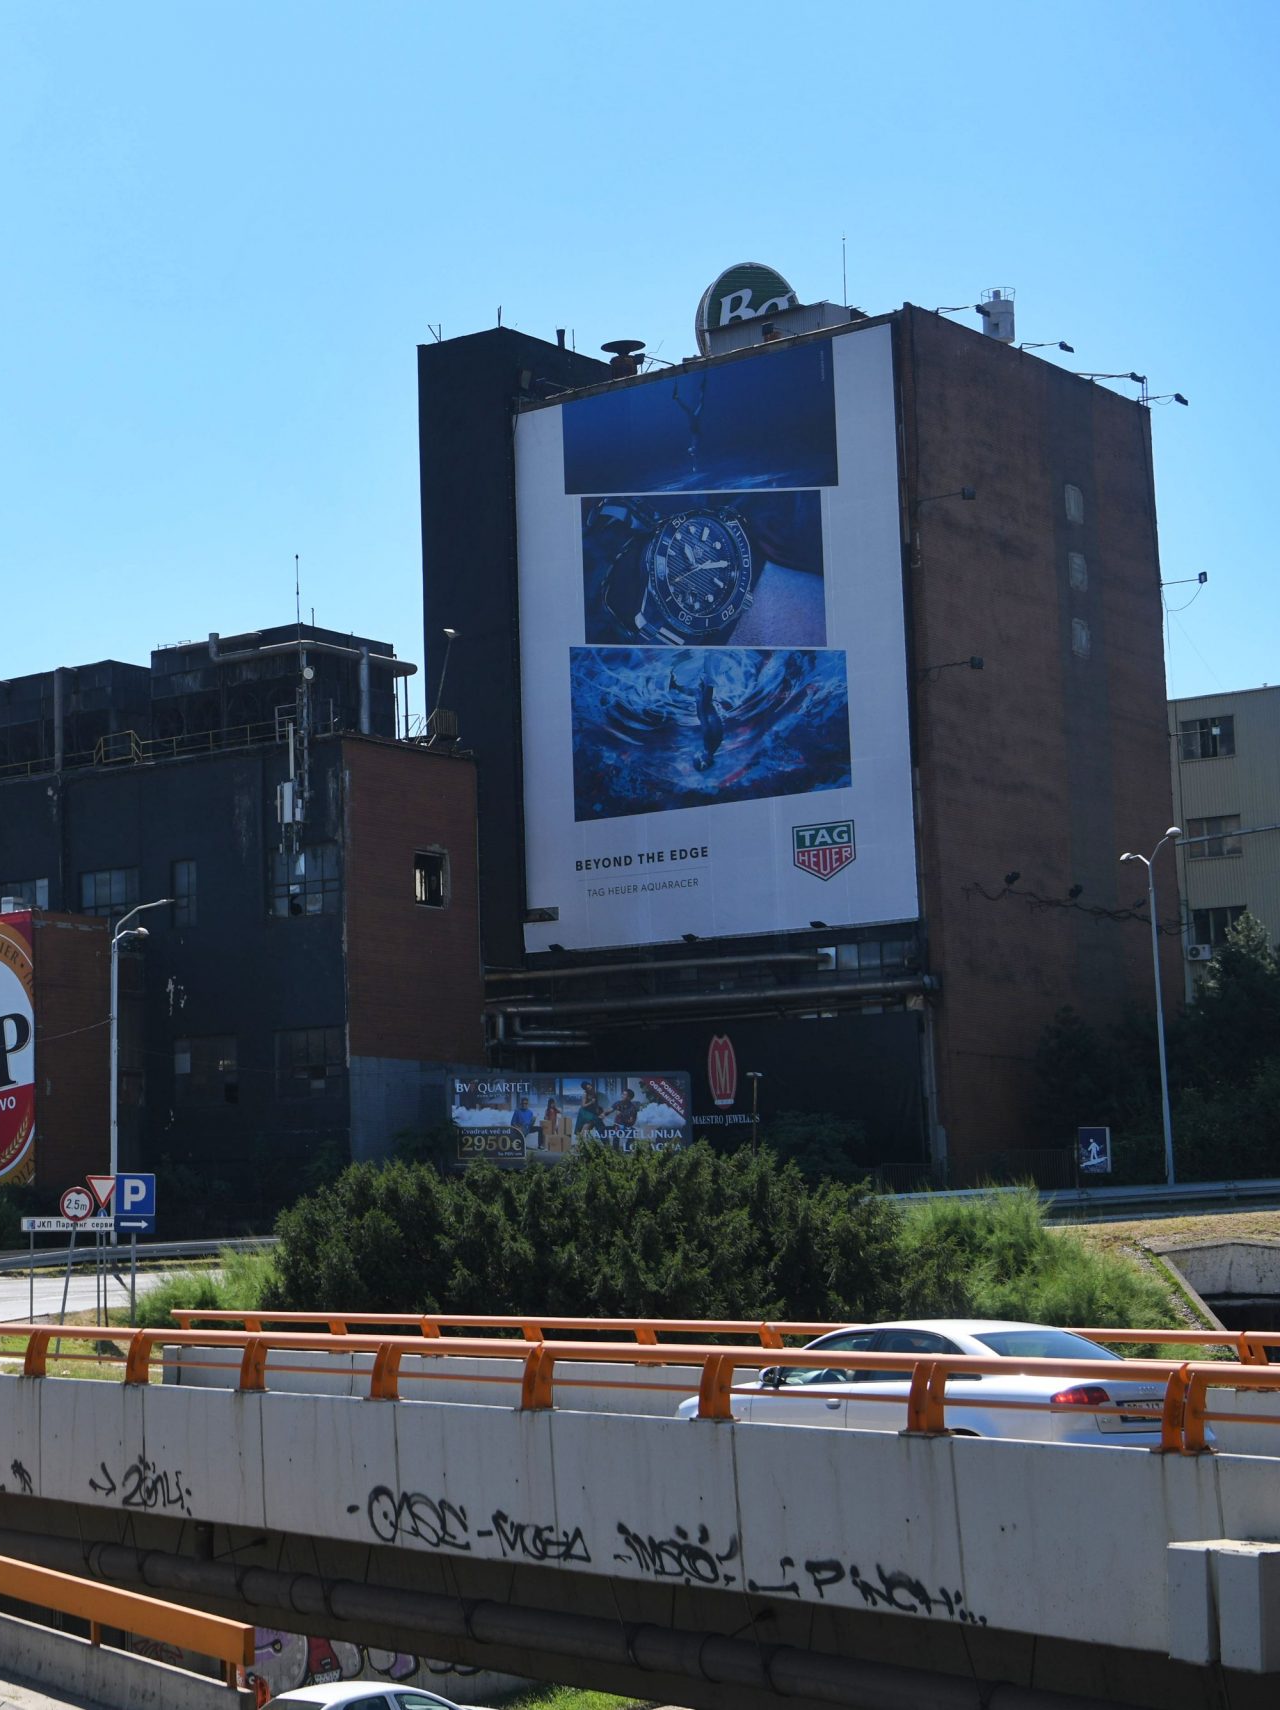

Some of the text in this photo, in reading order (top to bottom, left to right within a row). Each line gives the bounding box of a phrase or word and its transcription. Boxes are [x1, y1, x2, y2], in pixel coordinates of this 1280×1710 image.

[798, 826, 849, 847] TAG
[575, 846, 709, 871] BEYOND THE EDGE
[797, 847, 852, 874] HEUER
[587, 878, 699, 898] TAG HEUER AQUARACER
[477, 1082, 529, 1094] QUARTET
[649, 1080, 685, 1115] OGRANIČENA
[661, 1080, 684, 1104] PONUDA
[692, 1113, 760, 1127] MAESTRO JEWELLS
[462, 1135, 522, 1151] 2950€
[124, 1179, 146, 1210] P
